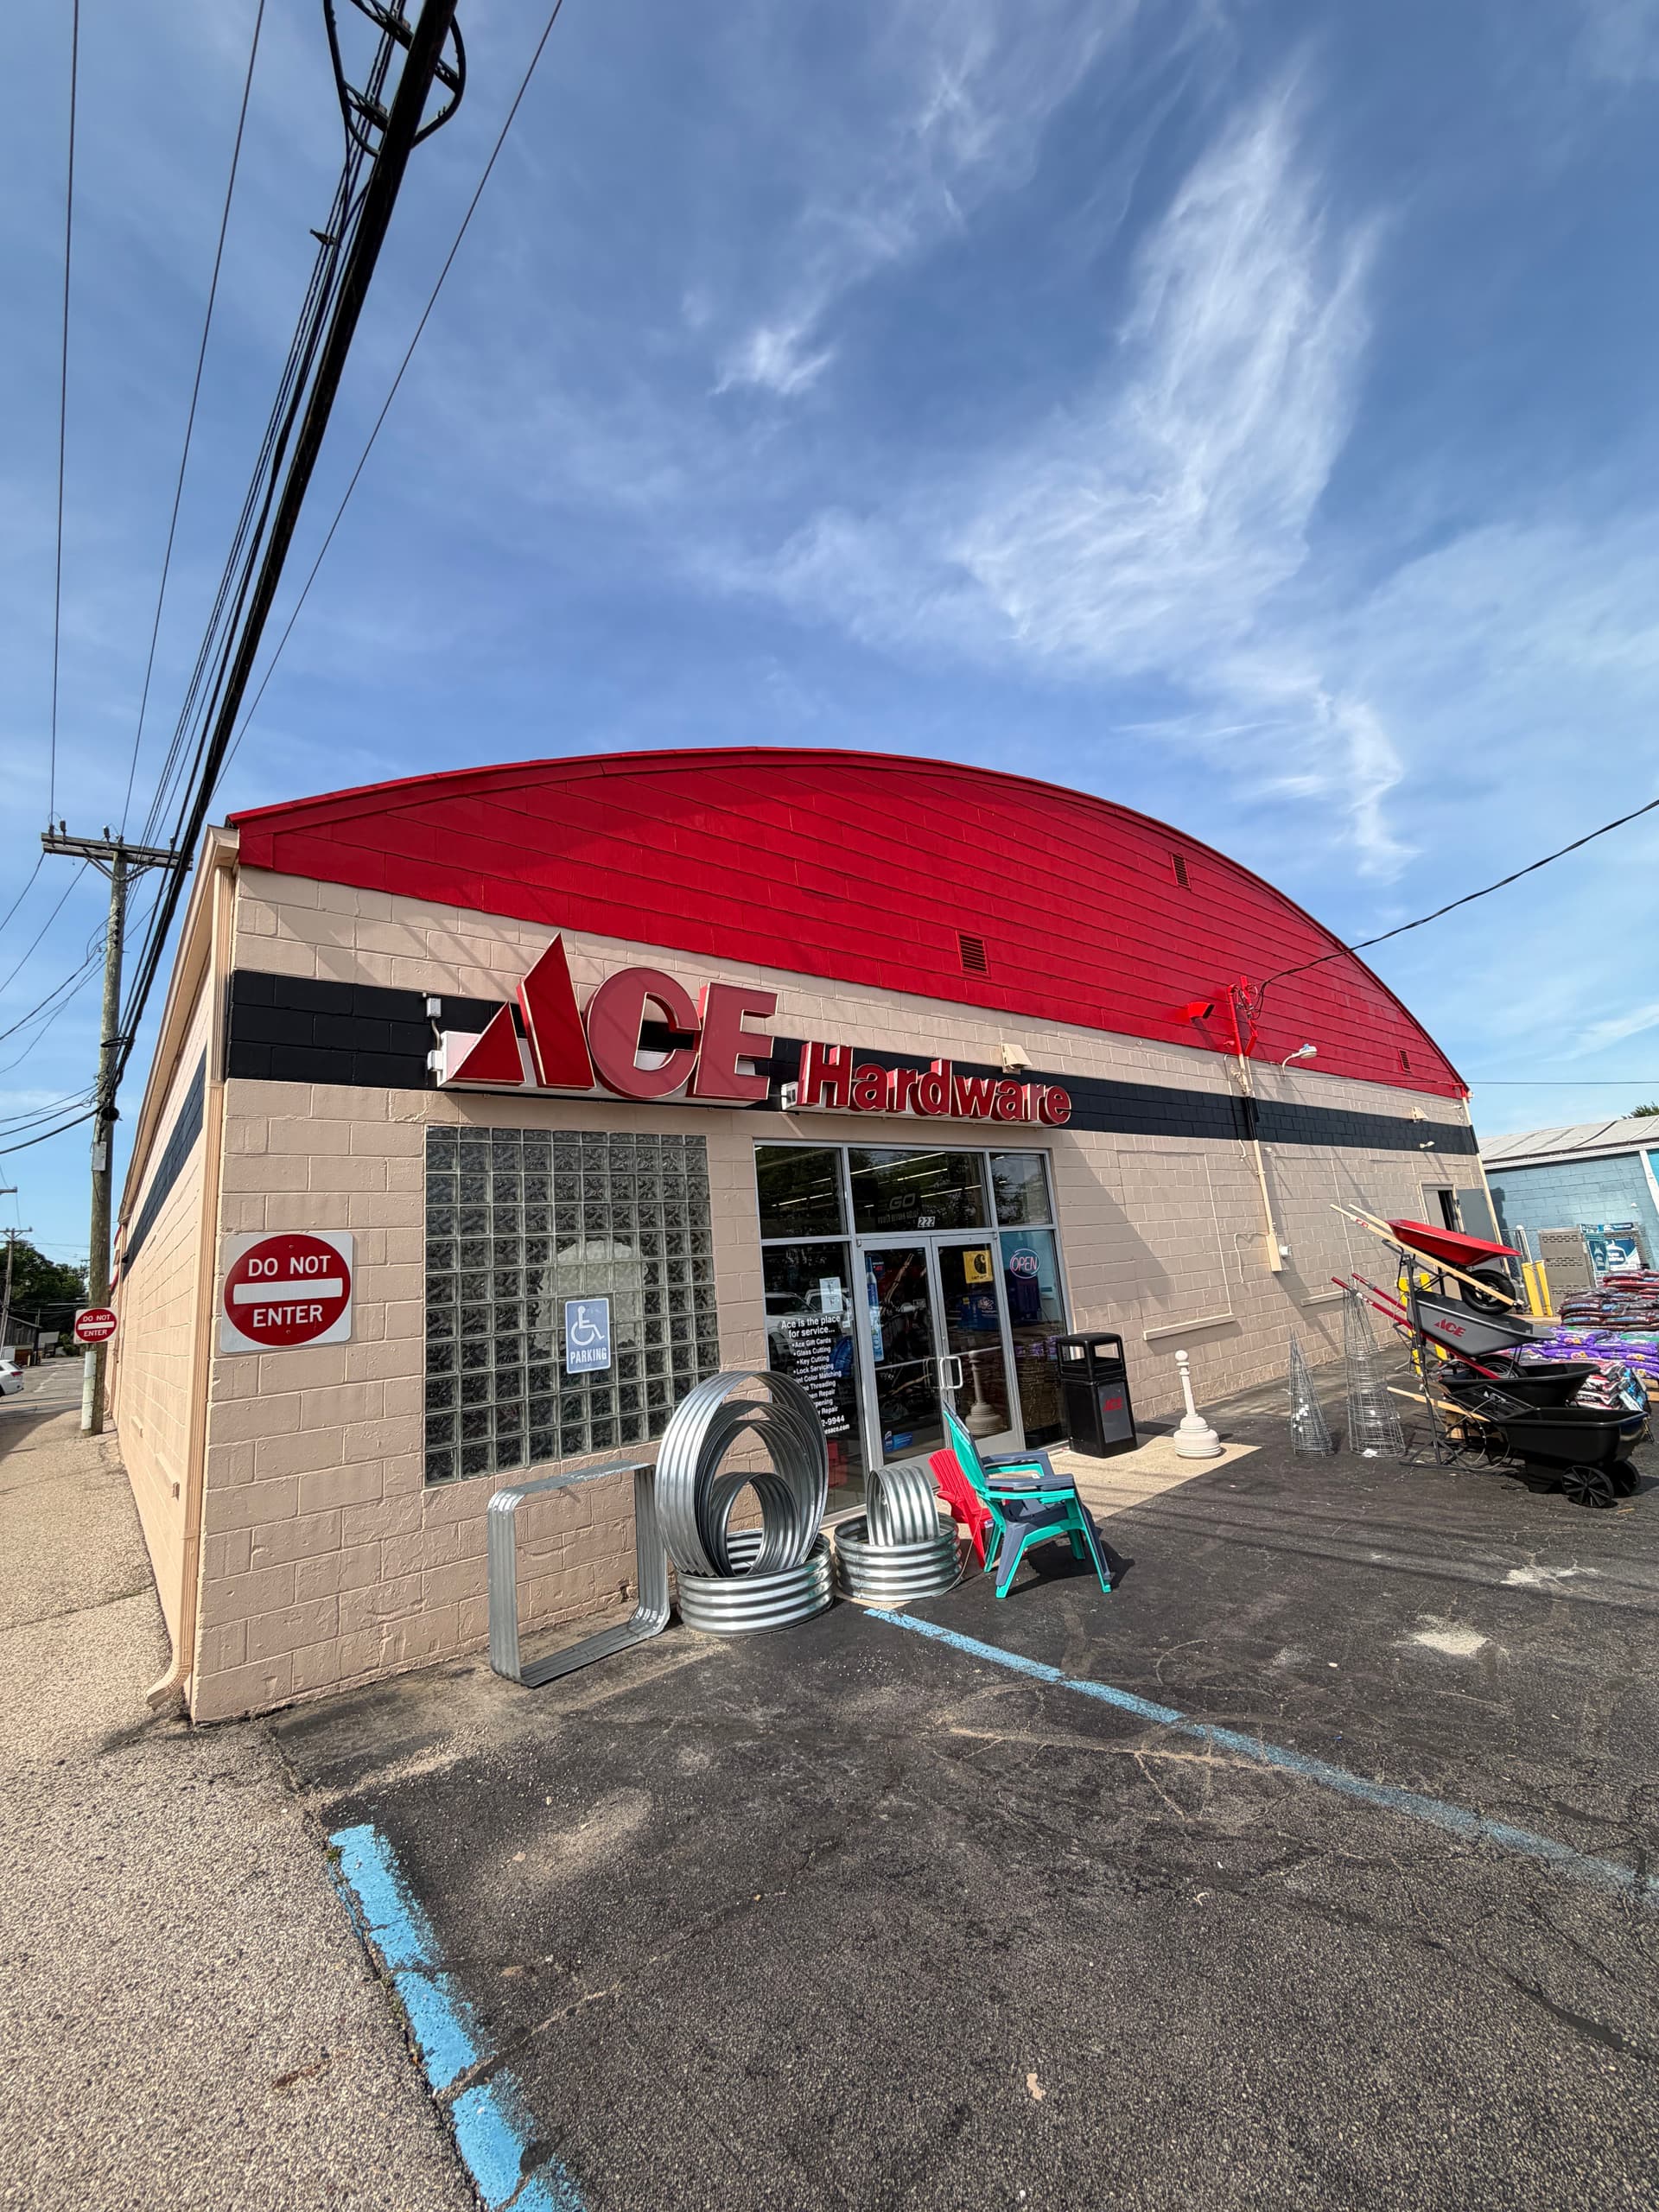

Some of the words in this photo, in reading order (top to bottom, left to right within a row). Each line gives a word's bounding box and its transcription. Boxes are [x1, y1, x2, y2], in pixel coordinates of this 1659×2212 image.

[452, 931, 779, 1100] ACE
[800, 1040, 1071, 1125] Hardware
[918, 1217, 934, 1227] 222
[248, 1257, 278, 1277] DO
[289, 1255, 331, 1274] NOT
[1011, 1256, 1037, 1271] OPEN
[253, 1305, 323, 1328] ENTER
[781, 1320, 796, 1329] Ace
[798, 1319, 805, 1327] is
[807, 1317, 819, 1326] the
[821, 1315, 841, 1326] place
[789, 1330, 799, 1338] for
[1433, 1319, 1466, 1338] ACE
[570, 1347, 607, 1364] PARKING
[810, 1355, 830, 1363] Cutting
[818, 1388, 836, 1397] Repair
[821, 1414, 845, 1427] 2-9944
